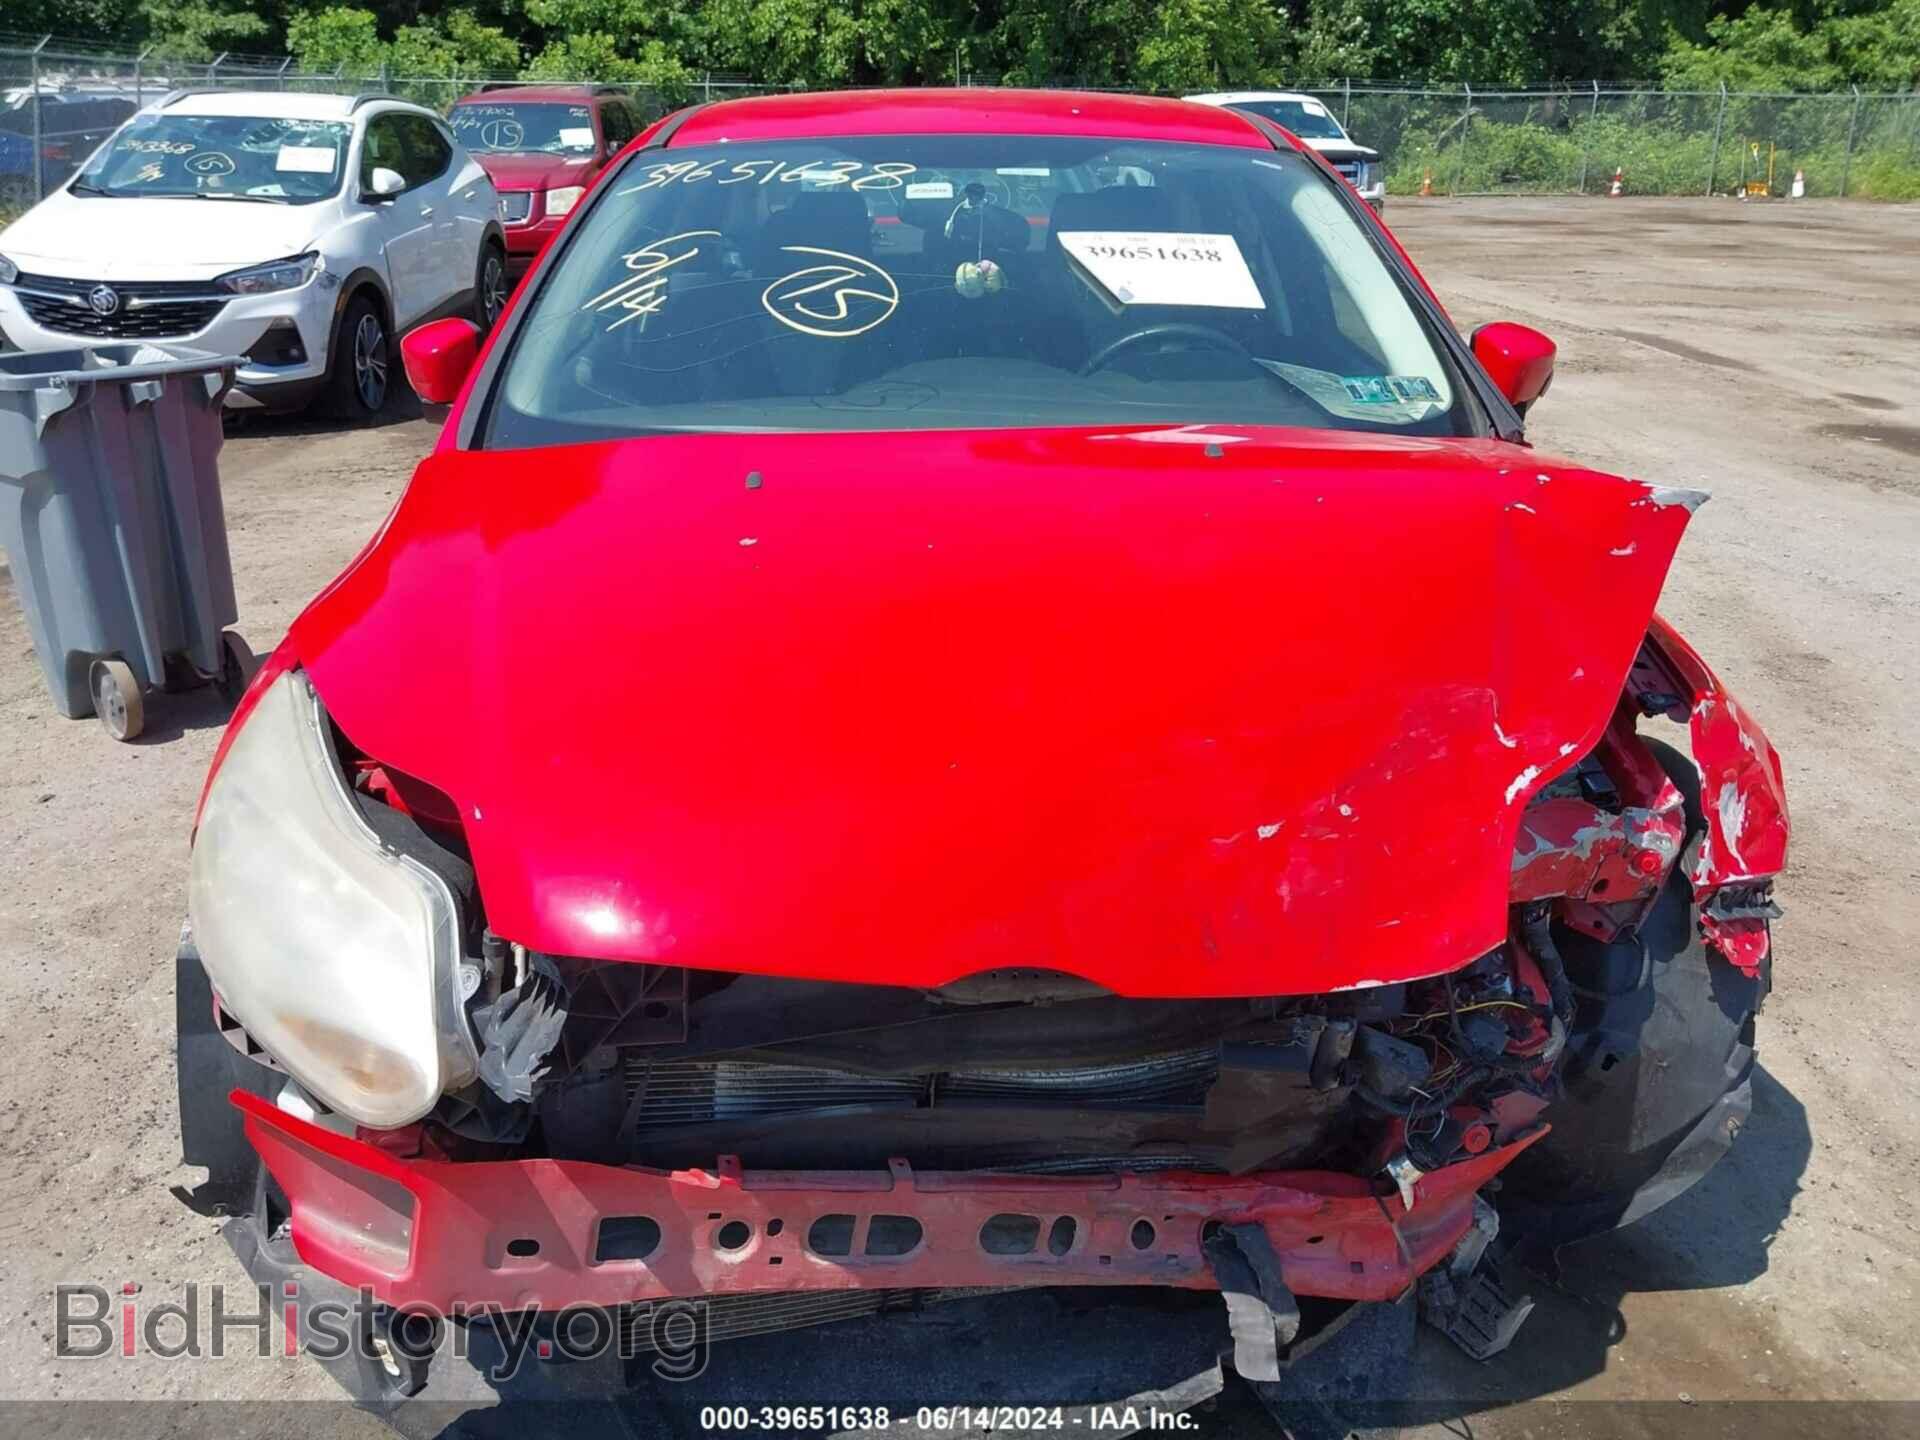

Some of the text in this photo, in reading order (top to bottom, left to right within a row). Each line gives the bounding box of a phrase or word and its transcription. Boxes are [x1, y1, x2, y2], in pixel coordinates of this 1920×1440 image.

[617, 159, 917, 196] 39651638
[1084, 245, 1223, 263] 39651638
[772, 264, 897, 324] 15
